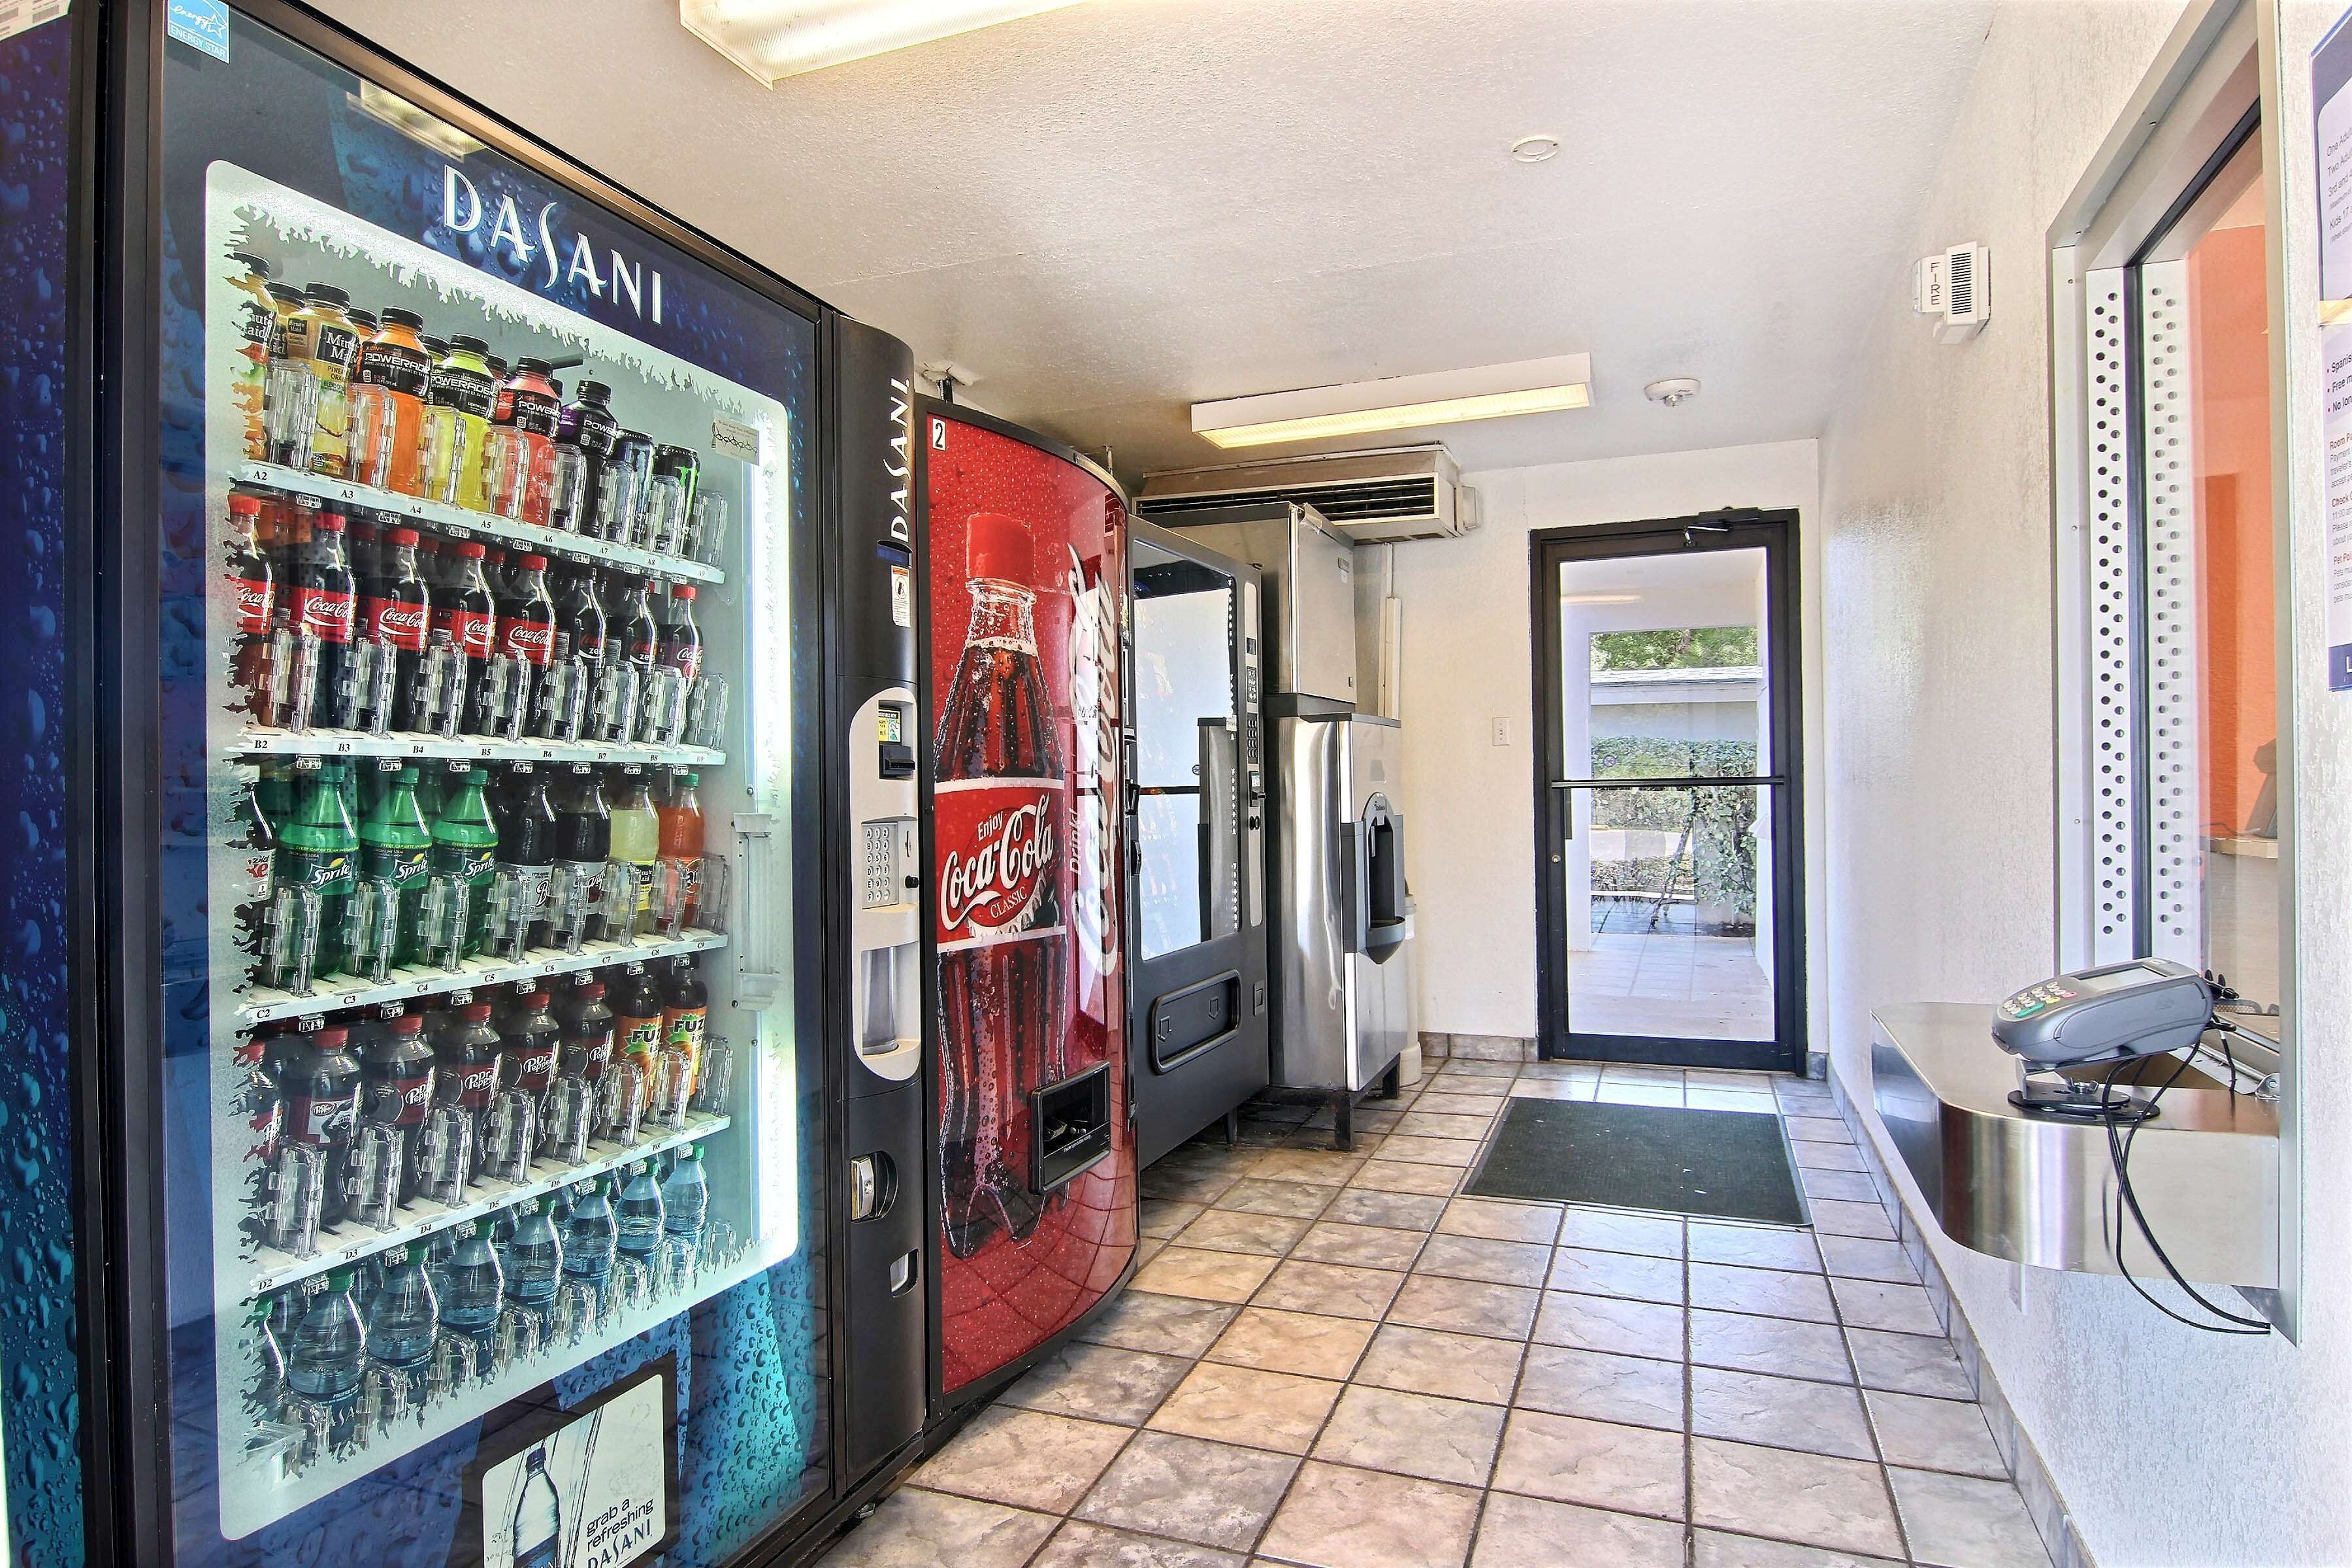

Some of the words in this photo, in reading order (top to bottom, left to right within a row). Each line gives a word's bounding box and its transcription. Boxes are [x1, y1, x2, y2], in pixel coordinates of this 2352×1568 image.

[171, 25, 204, 48] ENERGY
[205, 42, 225, 58] STAR
[444, 164, 662, 325] DASANI
[1931, 261, 1940, 305] FIRE
[2332, 379, 2345, 393] Free
[2333, 401, 2341, 413] No
[2343, 396, 2352, 407] lon
[935, 423, 943, 448] 2
[884, 378, 911, 542] DASANI
[253, 470, 267, 481] A2
[340, 489, 353, 498] A3
[2332, 494, 2349, 507] Check
[410, 505, 421, 514] A4
[481, 519, 491, 529] A5
[255, 740, 268, 749] B2
[338, 743, 350, 752] B3
[412, 745, 423, 754] B4
[977, 811, 1004, 841] Enjoy
[941, 792, 1054, 930] Coca-Cola
[312, 862, 351, 883] Sprite
[990, 886, 1028, 919] CLASSIC
[545, 964, 555, 973] C6
[484, 973, 495, 982] C5
[417, 984, 428, 992] C4
[343, 995, 356, 1004] C3
[257, 1008, 270, 1019] C2
[674, 1019, 706, 1032] FUZ
[536, 1055, 547, 1064] Dr
[479, 1070, 491, 1079] Dr
[551, 1179, 561, 1187] D6
[489, 1201, 499, 1209] D5
[419, 1224, 431, 1234] D4
[345, 1250, 357, 1260] D3
[258, 1279, 272, 1290] D2
[587, 1505, 617, 1537] grab
[621, 1499, 630, 1511] a
[587, 1499, 653, 1552] refreshing
[587, 1518, 651, 1568] DASANI
